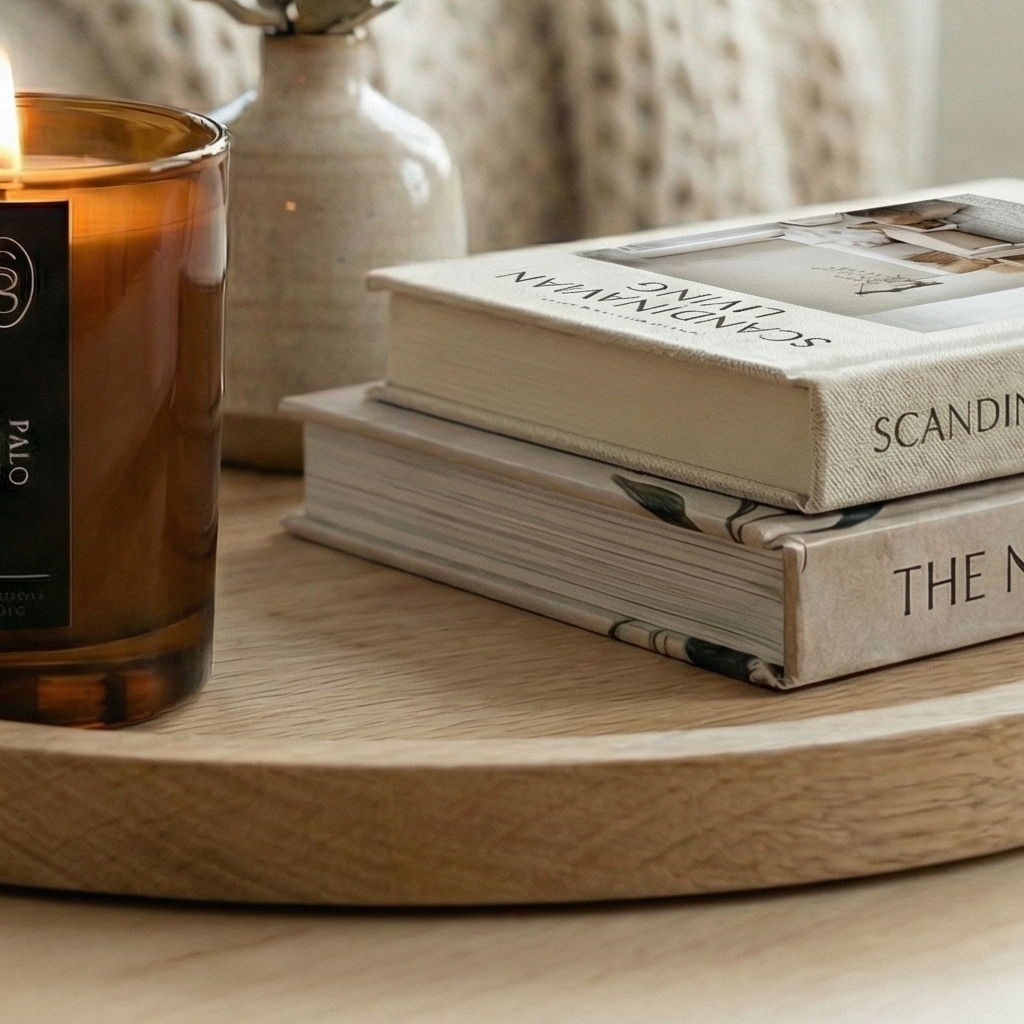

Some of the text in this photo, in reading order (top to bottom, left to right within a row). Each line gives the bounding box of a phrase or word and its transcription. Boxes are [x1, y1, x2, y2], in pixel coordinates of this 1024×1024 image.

[494, 270, 833, 348] SCANDINAVIAN
[626, 281, 786, 319] LIVING
[8, 419, 30, 485] PALO
[893, 550, 986, 616] THE
